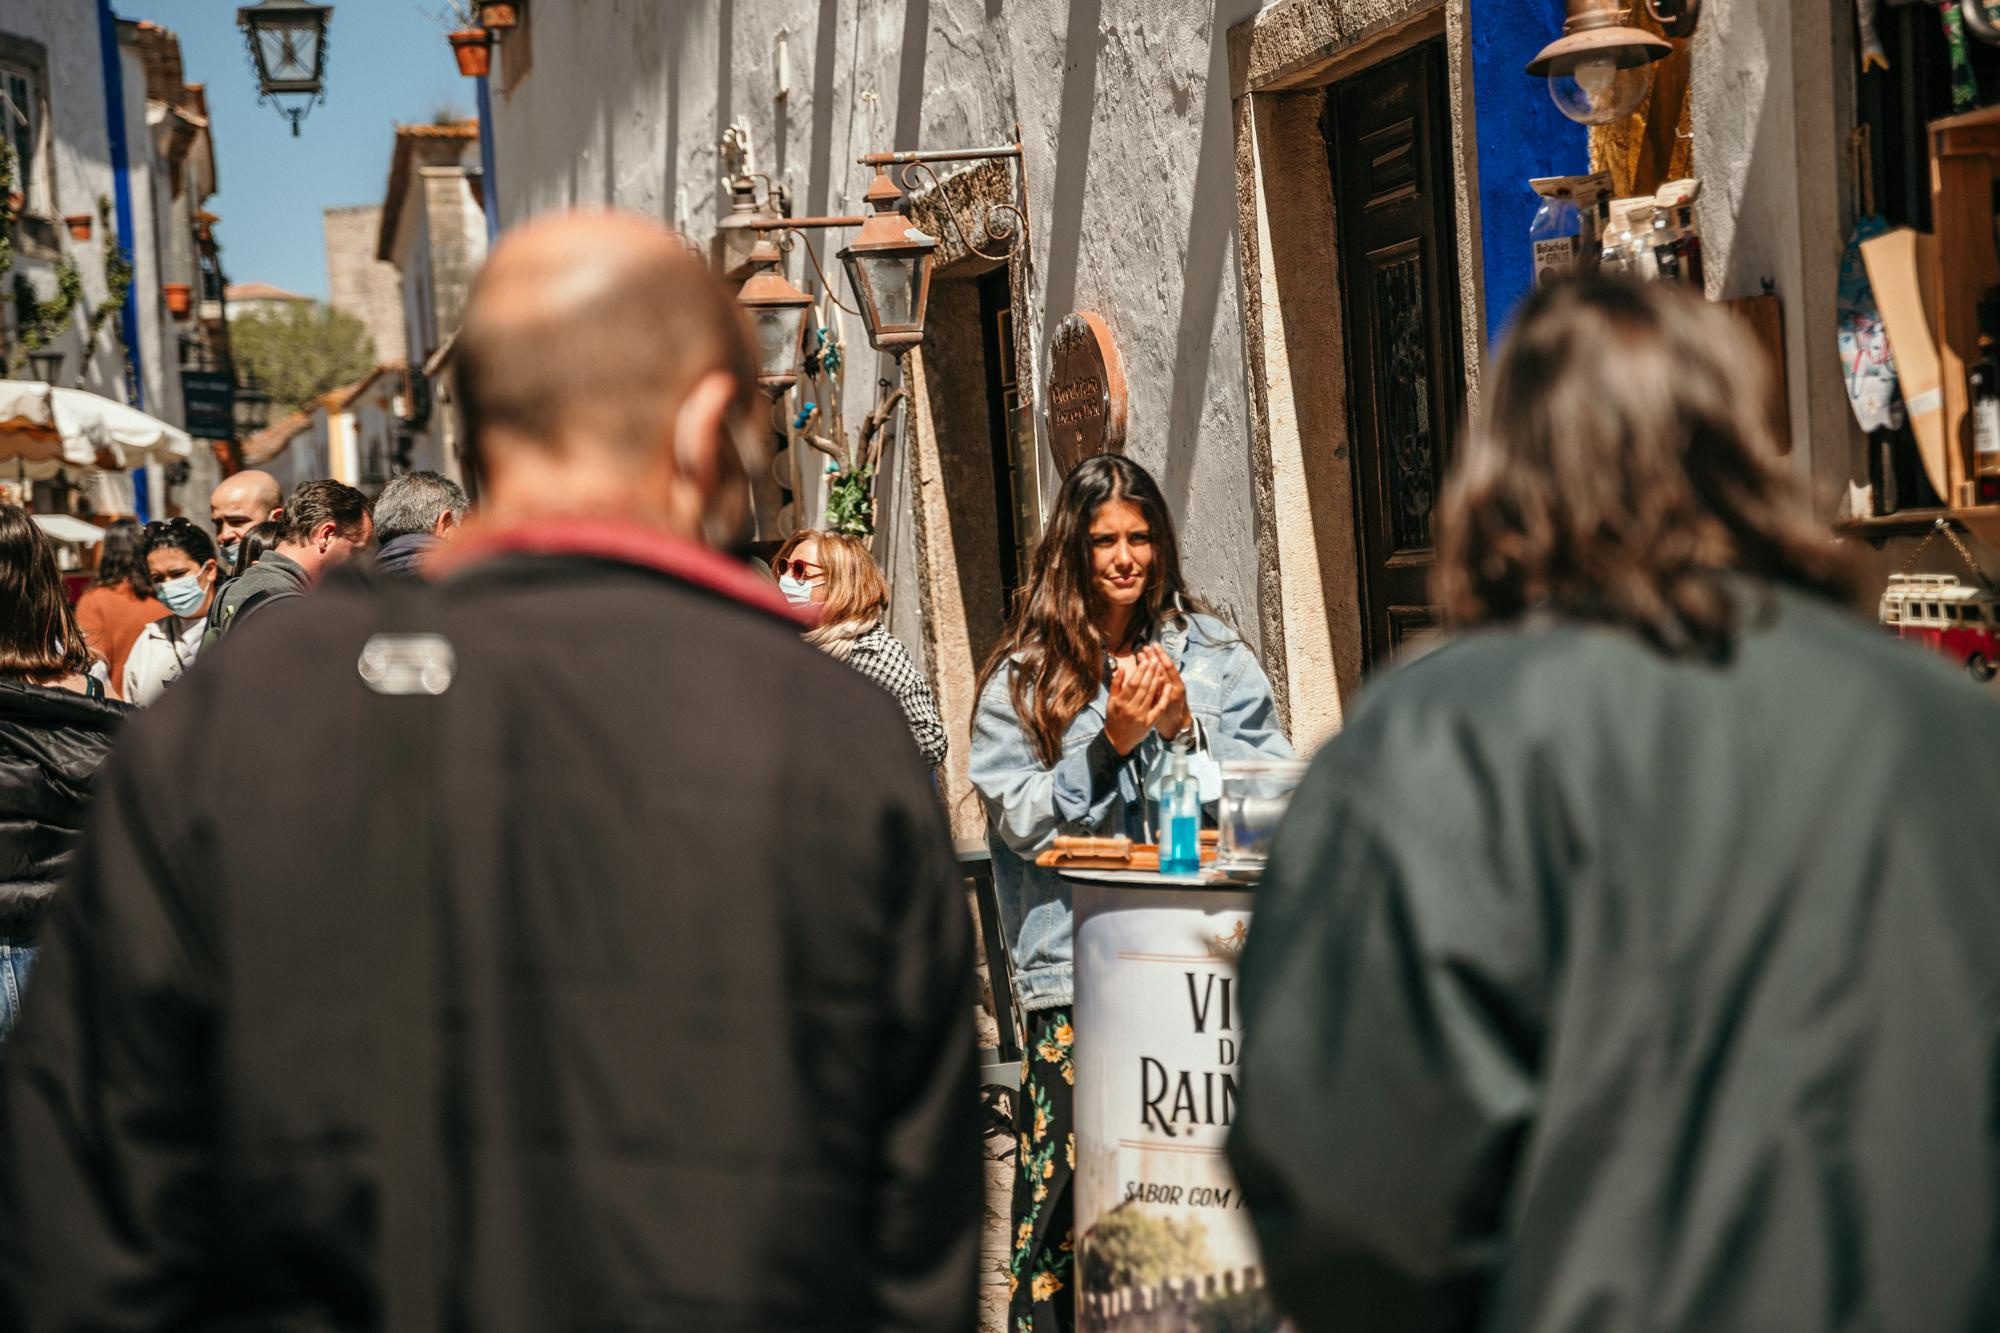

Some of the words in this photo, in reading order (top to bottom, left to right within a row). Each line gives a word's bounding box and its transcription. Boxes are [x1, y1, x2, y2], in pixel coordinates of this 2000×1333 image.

[1185, 972, 1240, 1034] VI
[1219, 1039, 1240, 1067] D
[1124, 1181, 1183, 1206] SABOR
[1188, 1187, 1232, 1209] COM
